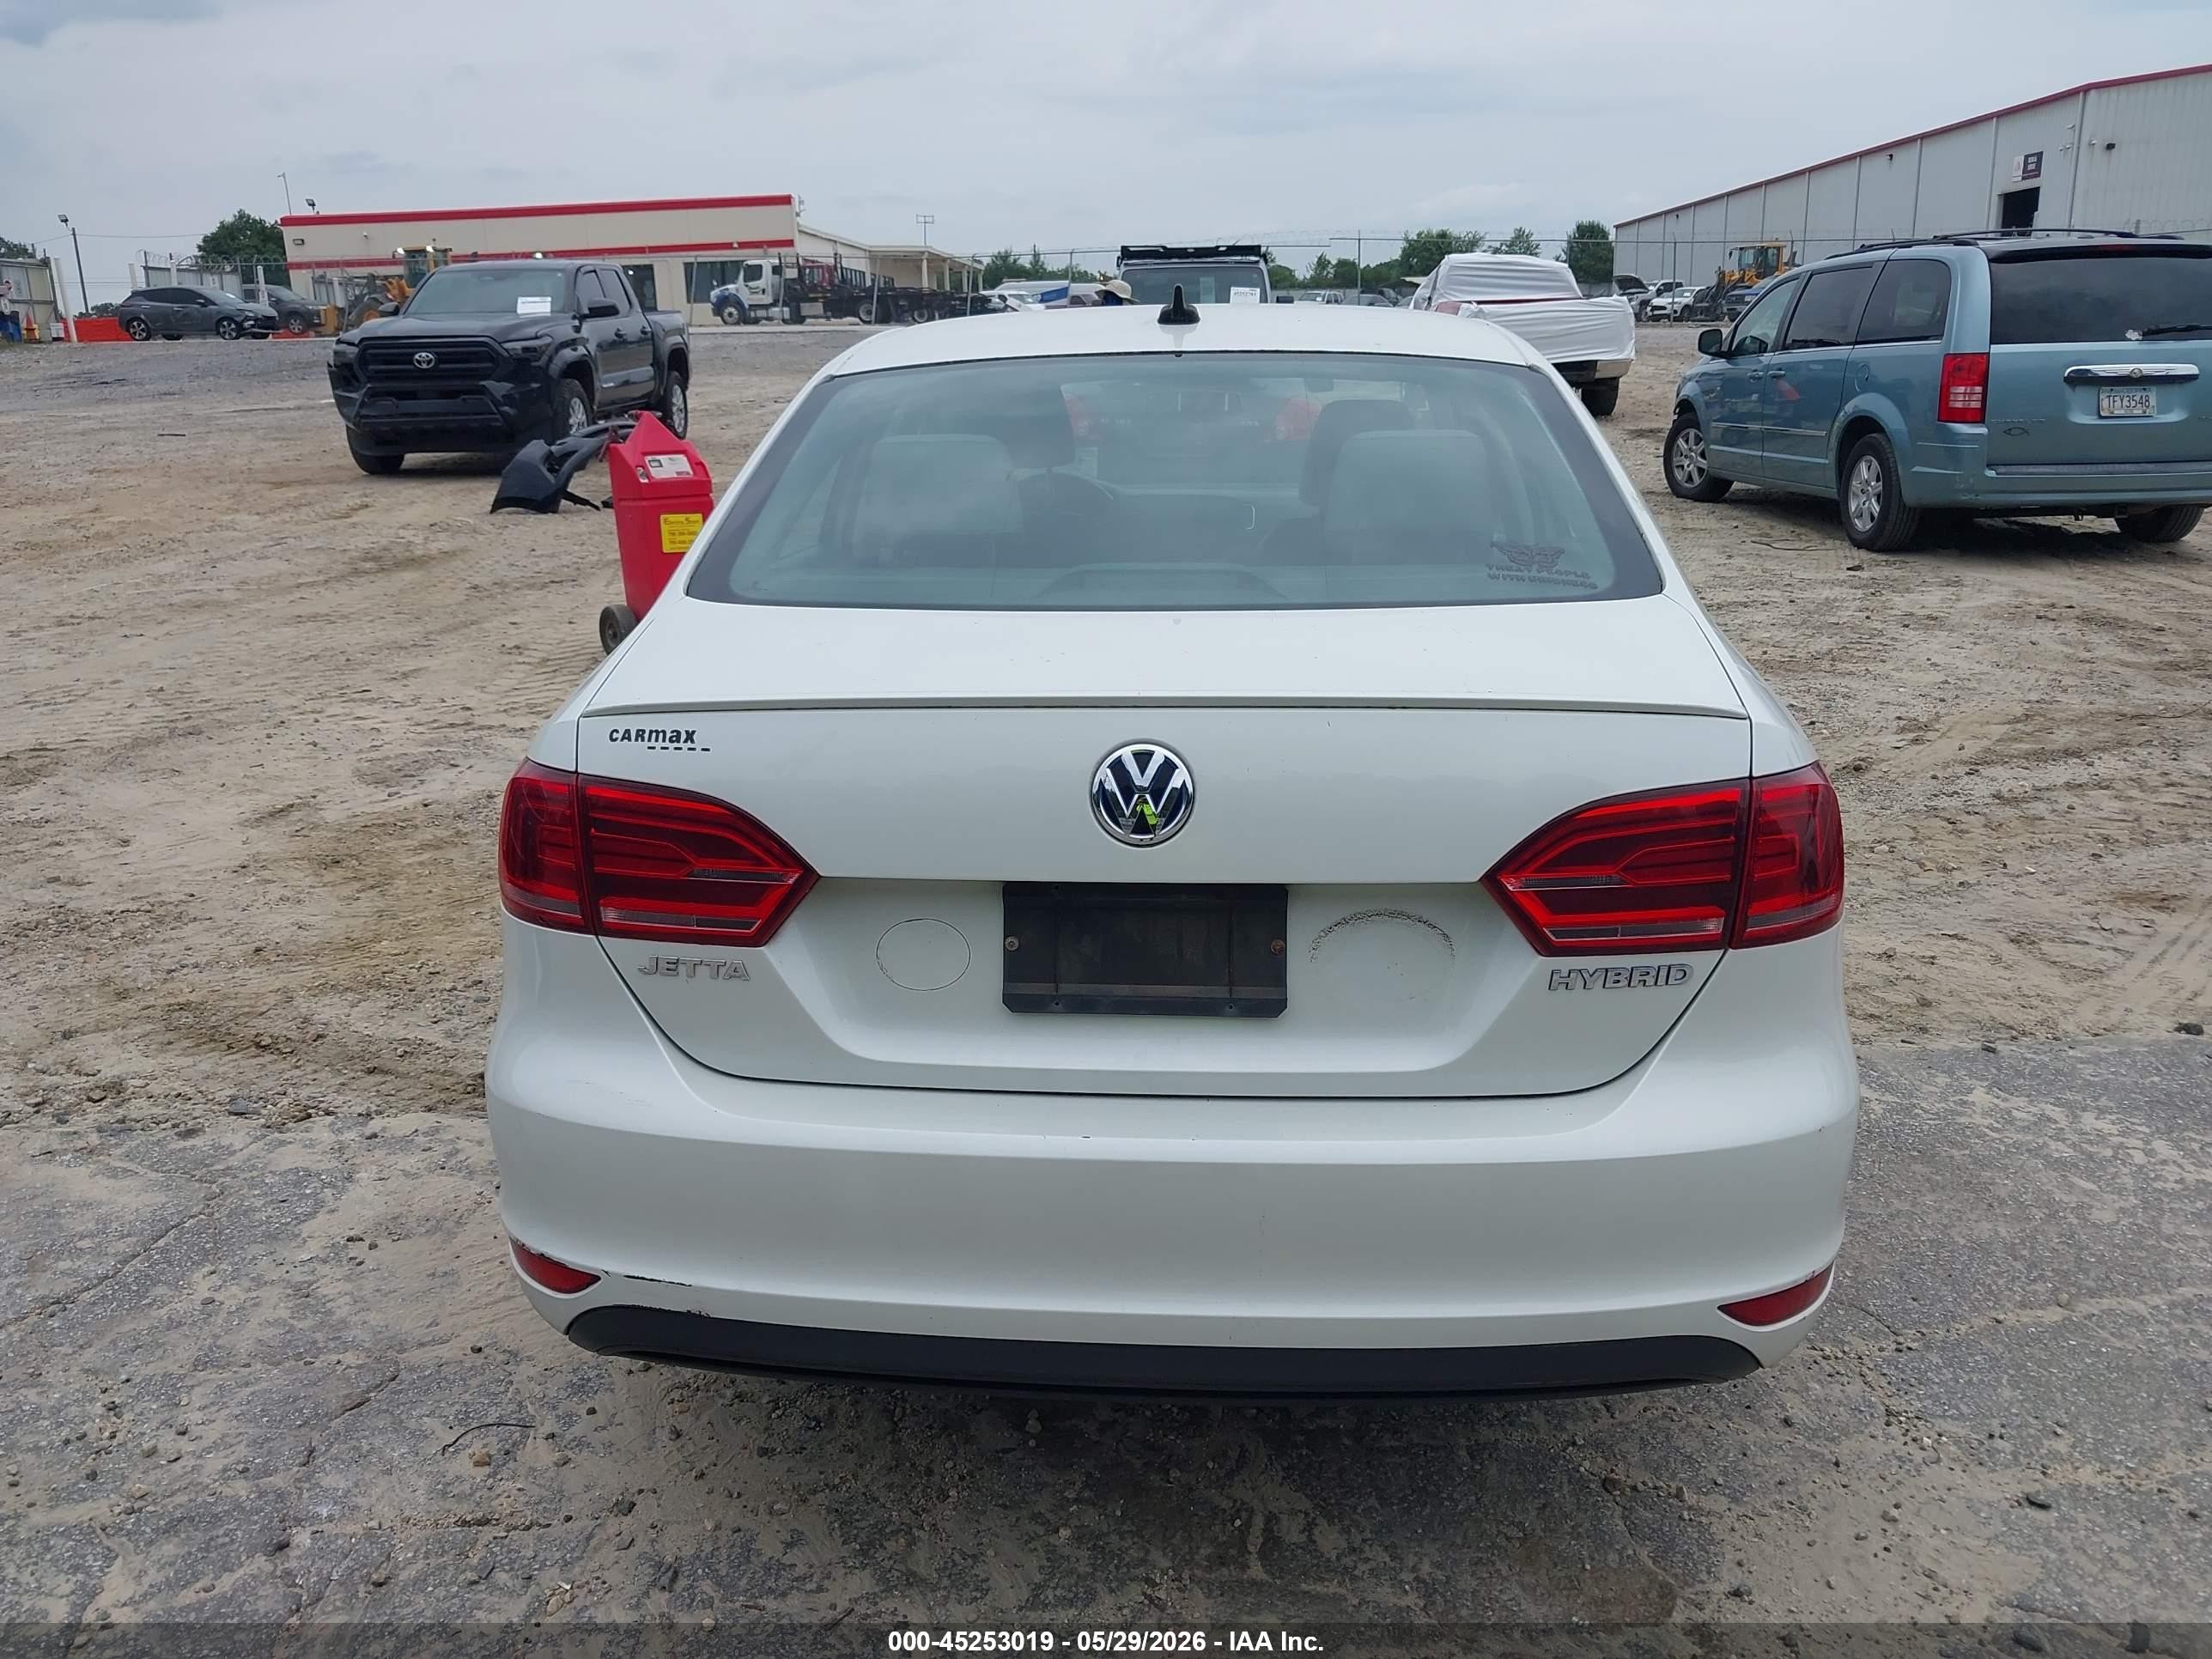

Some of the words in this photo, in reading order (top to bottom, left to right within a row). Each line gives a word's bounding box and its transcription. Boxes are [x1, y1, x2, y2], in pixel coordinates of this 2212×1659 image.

[2106, 394, 2151, 409] TFY3548
[1092, 744, 1194, 846] VW
[636, 955, 750, 981] JETTA
[1548, 963, 1694, 991] HYBRID
